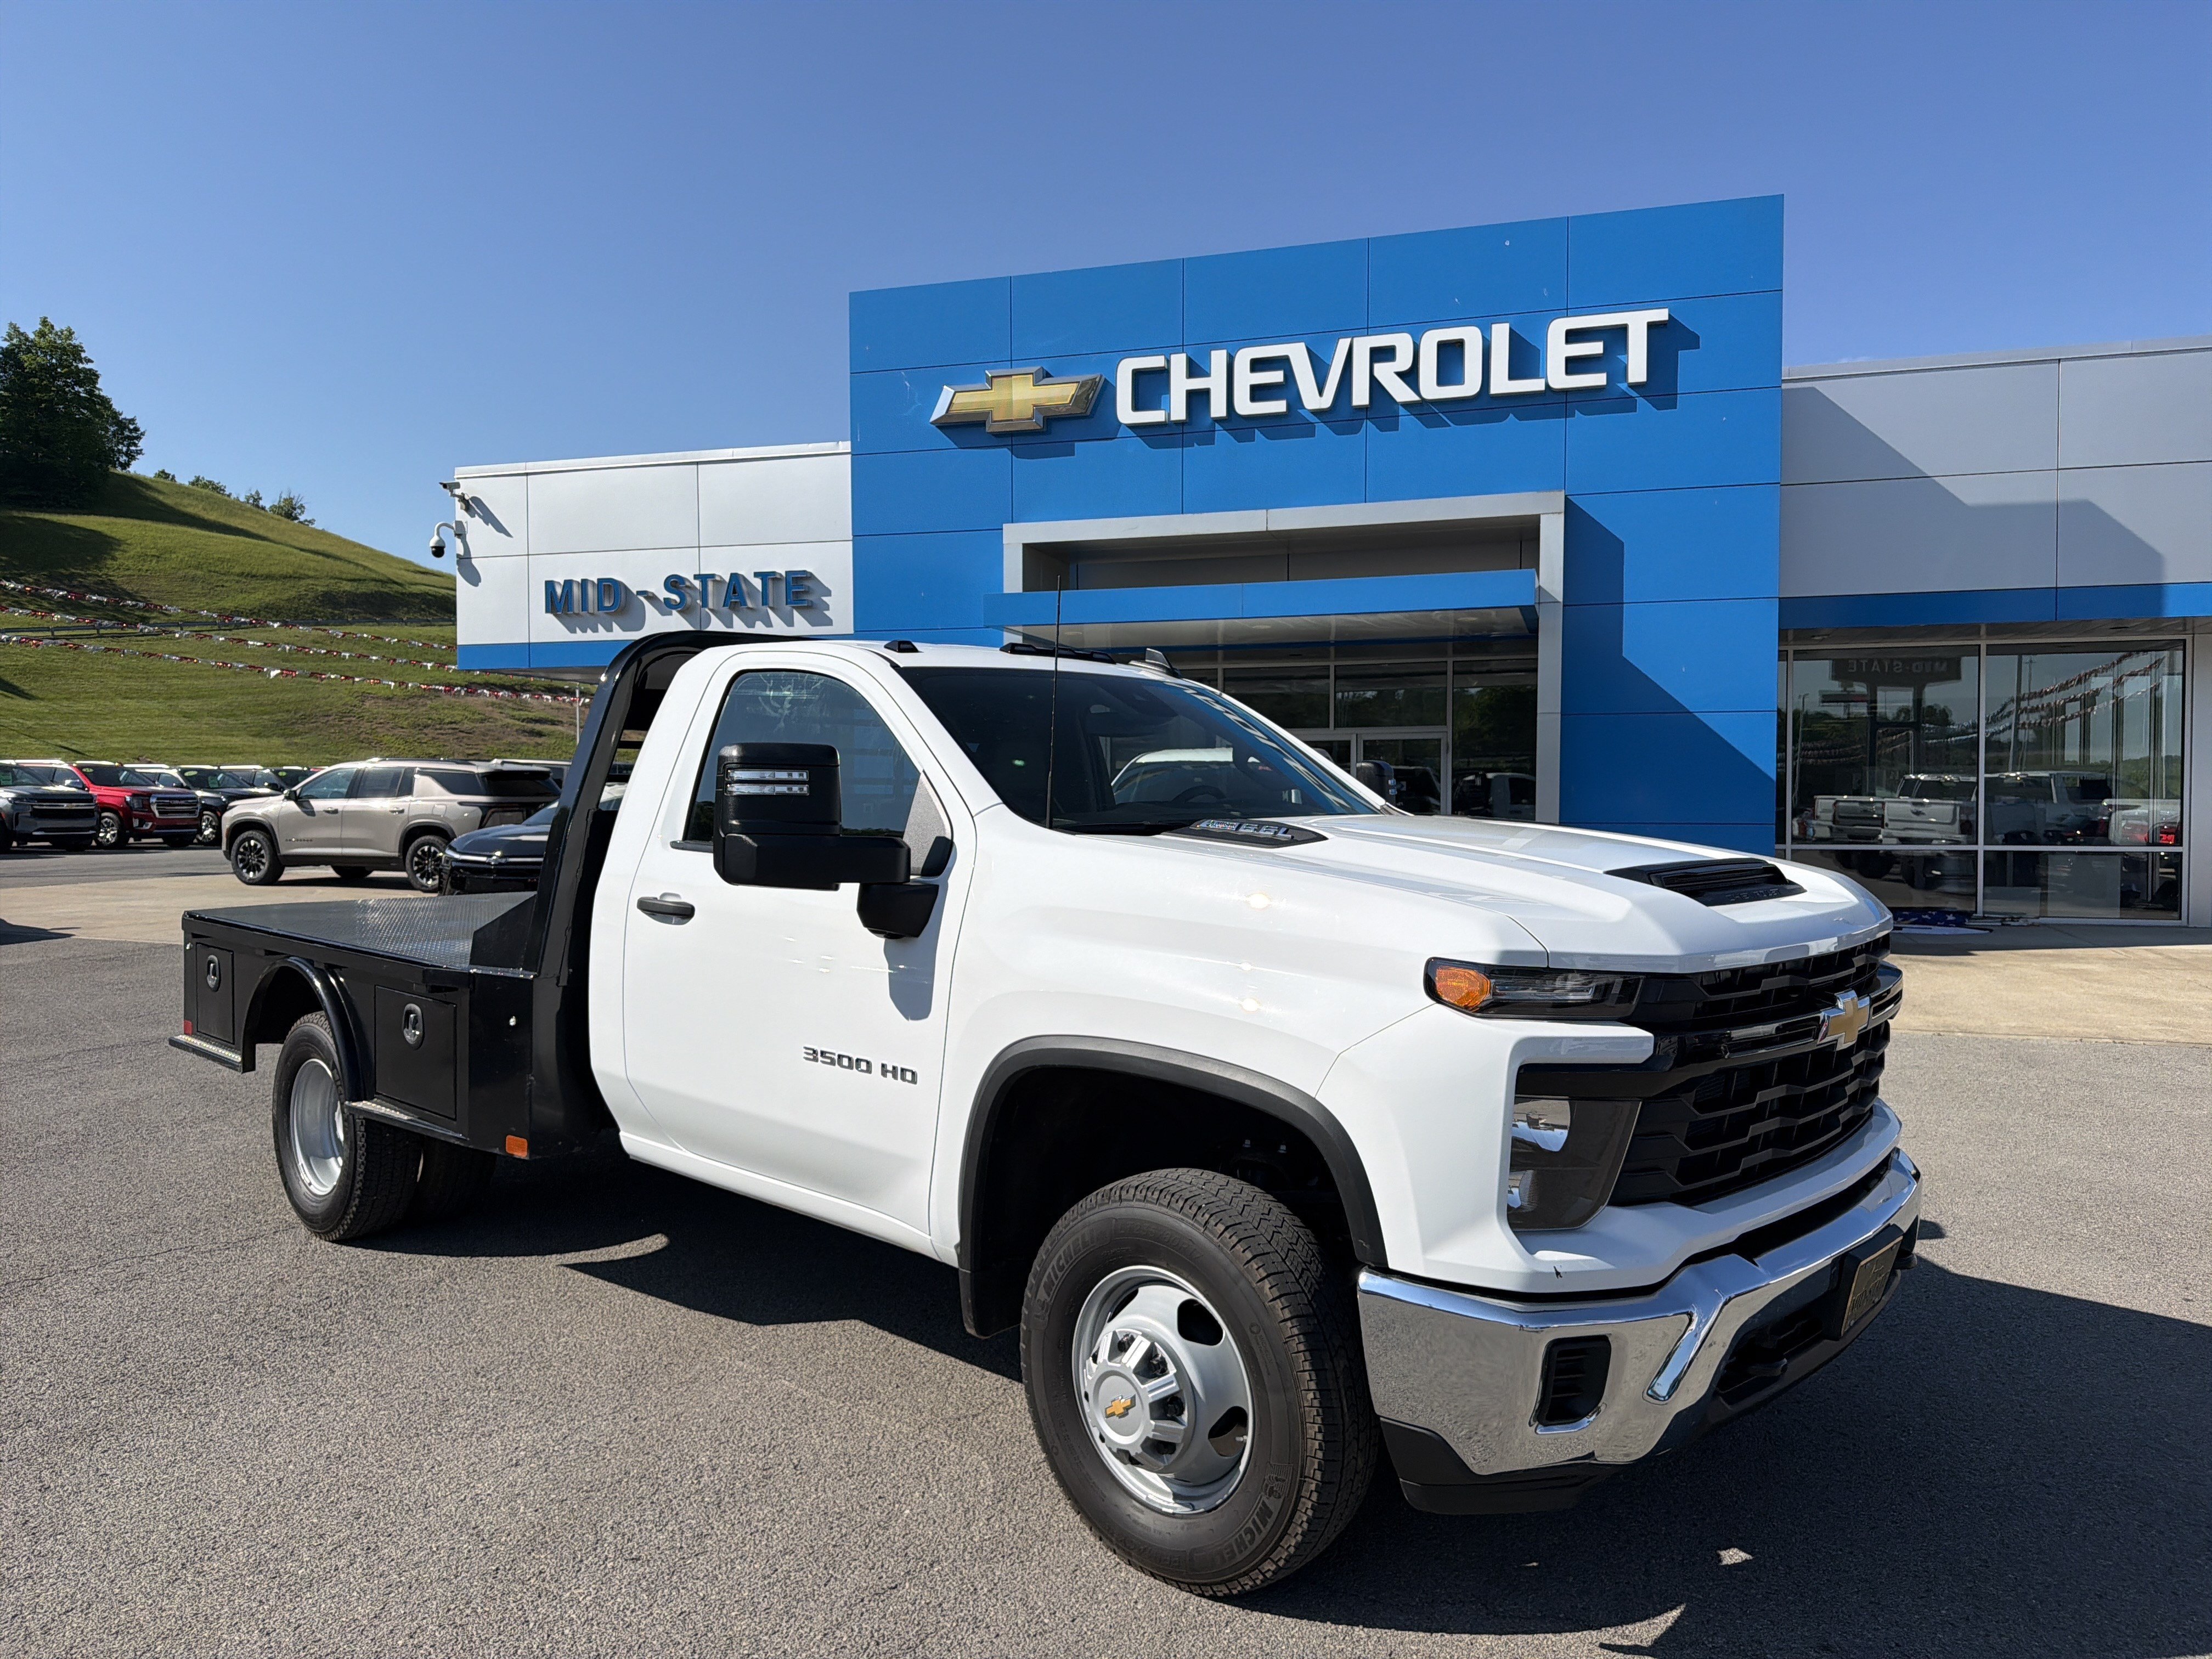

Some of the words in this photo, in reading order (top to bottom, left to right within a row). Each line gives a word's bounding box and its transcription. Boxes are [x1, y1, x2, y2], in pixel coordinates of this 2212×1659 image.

[1116, 308, 1669, 426] CHEVROLET
[544, 570, 809, 614] MID-STATE
[803, 1046, 872, 1075] 3500
[881, 1062, 918, 1085] HD
[1042, 1222, 1106, 1299] MICHELI
[1192, 1499, 1274, 1568] MICHEL
